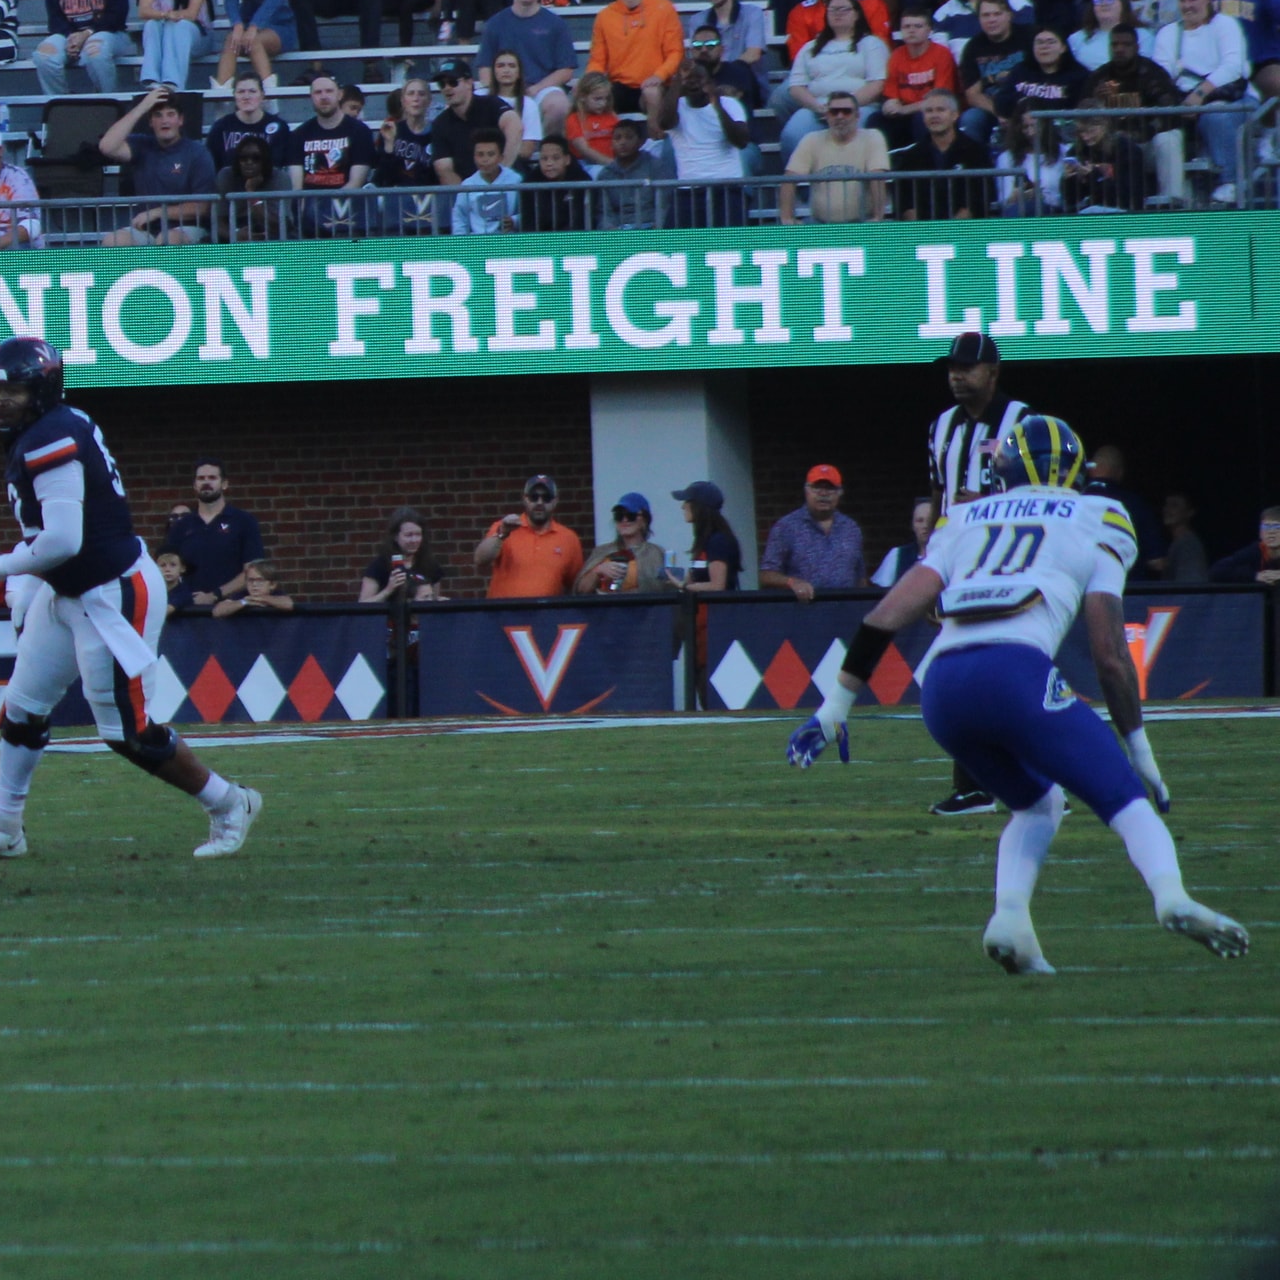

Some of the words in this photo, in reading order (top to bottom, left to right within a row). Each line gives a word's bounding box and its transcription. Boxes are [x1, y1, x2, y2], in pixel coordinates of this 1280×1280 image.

[304, 138, 349, 152] VIRGINIA
[325, 247, 867, 357] FREIGHT
[916, 236, 1198, 339] LINE
[965, 498, 1076, 524] MATTHEWS
[964, 523, 1046, 580] 10
[956, 586, 1014, 604] DOUGLAS
